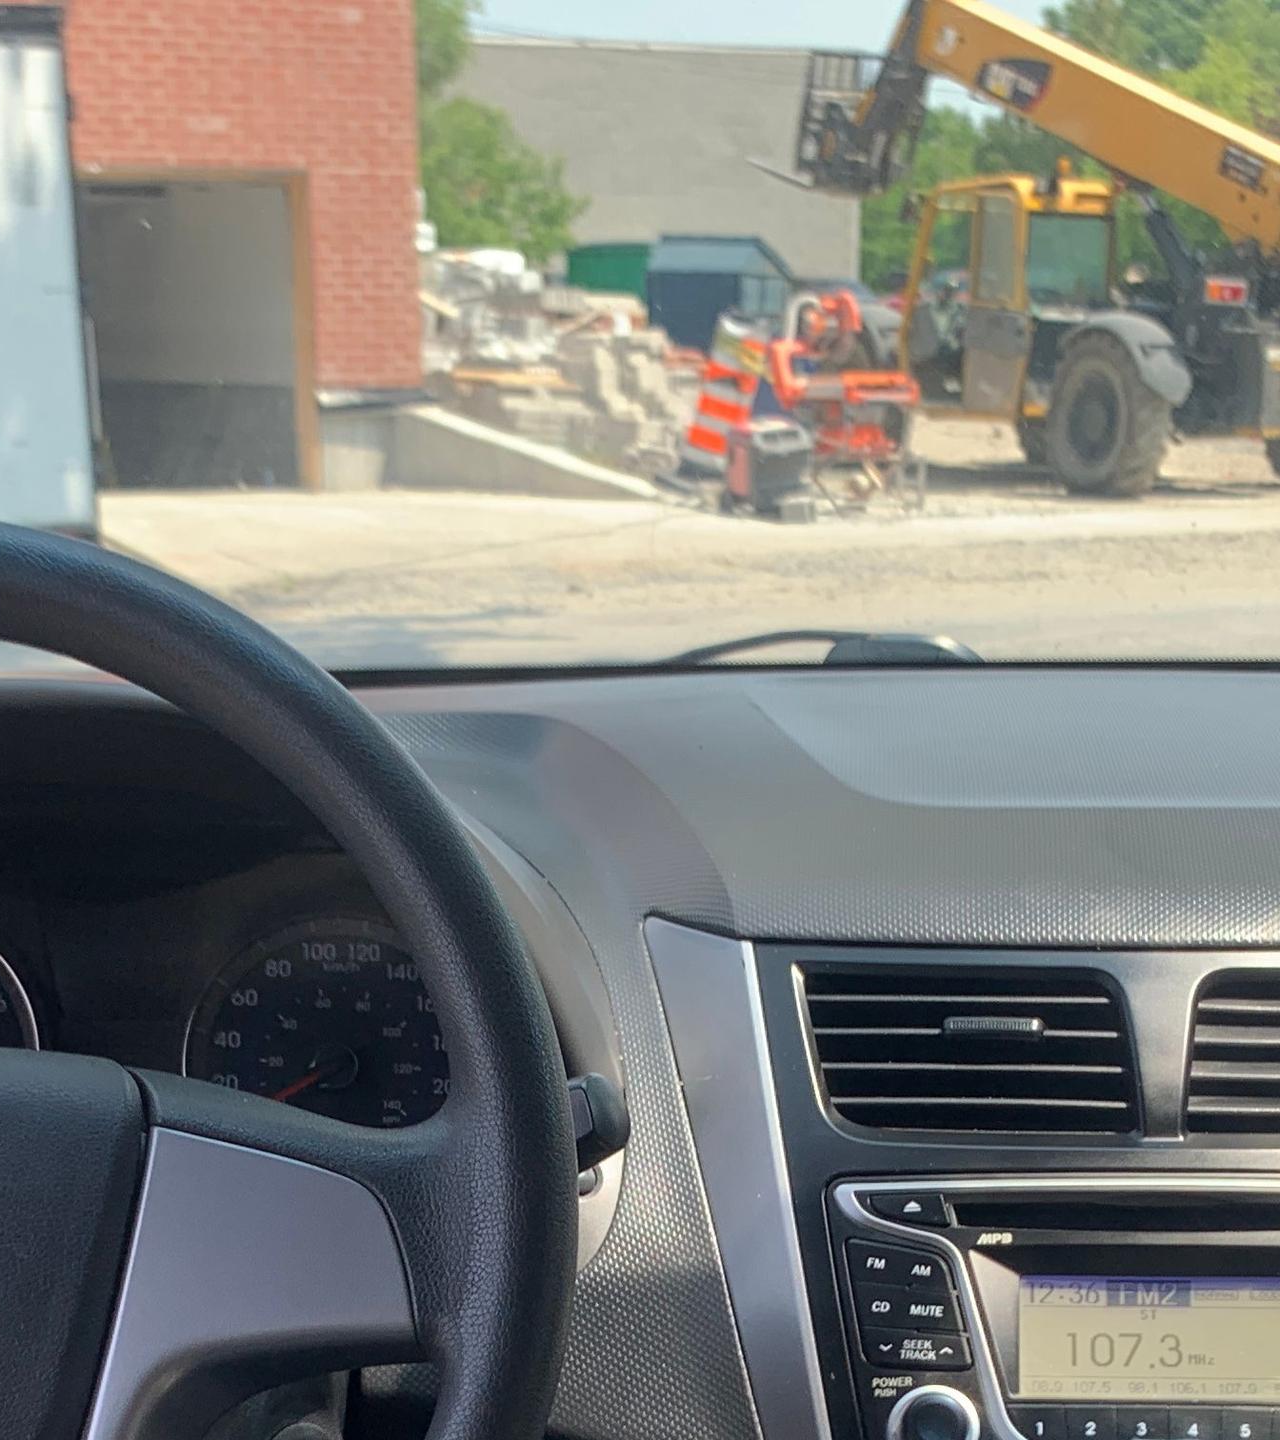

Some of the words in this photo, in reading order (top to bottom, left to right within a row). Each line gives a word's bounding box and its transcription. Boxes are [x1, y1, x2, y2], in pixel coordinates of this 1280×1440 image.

[302, 943, 336, 961] 100
[348, 944, 380, 962] 120
[265, 959, 291, 978] 80
[231, 988, 258, 1006] 60
[214, 1031, 241, 1048] 40
[866, 1257, 886, 1270] FM
[911, 1265, 931, 1276] AM
[871, 1301, 890, 1313] CD
[909, 1304, 944, 1318] MUTE
[903, 1340, 932, 1350] SEEK
[1066, 1333, 1183, 1369] 107.3
[1188, 1354, 1215, 1366] MHz
[899, 1348, 936, 1360] TRACK
[872, 1376, 913, 1388] POWER
[874, 1388, 896, 1398] PUSH
[1035, 1422, 1044, 1435] 1
[1085, 1422, 1096, 1435] 2
[1136, 1422, 1148, 1436] 3
[1187, 1423, 1199, 1436] 4
[1239, 1424, 1251, 1438] 5
